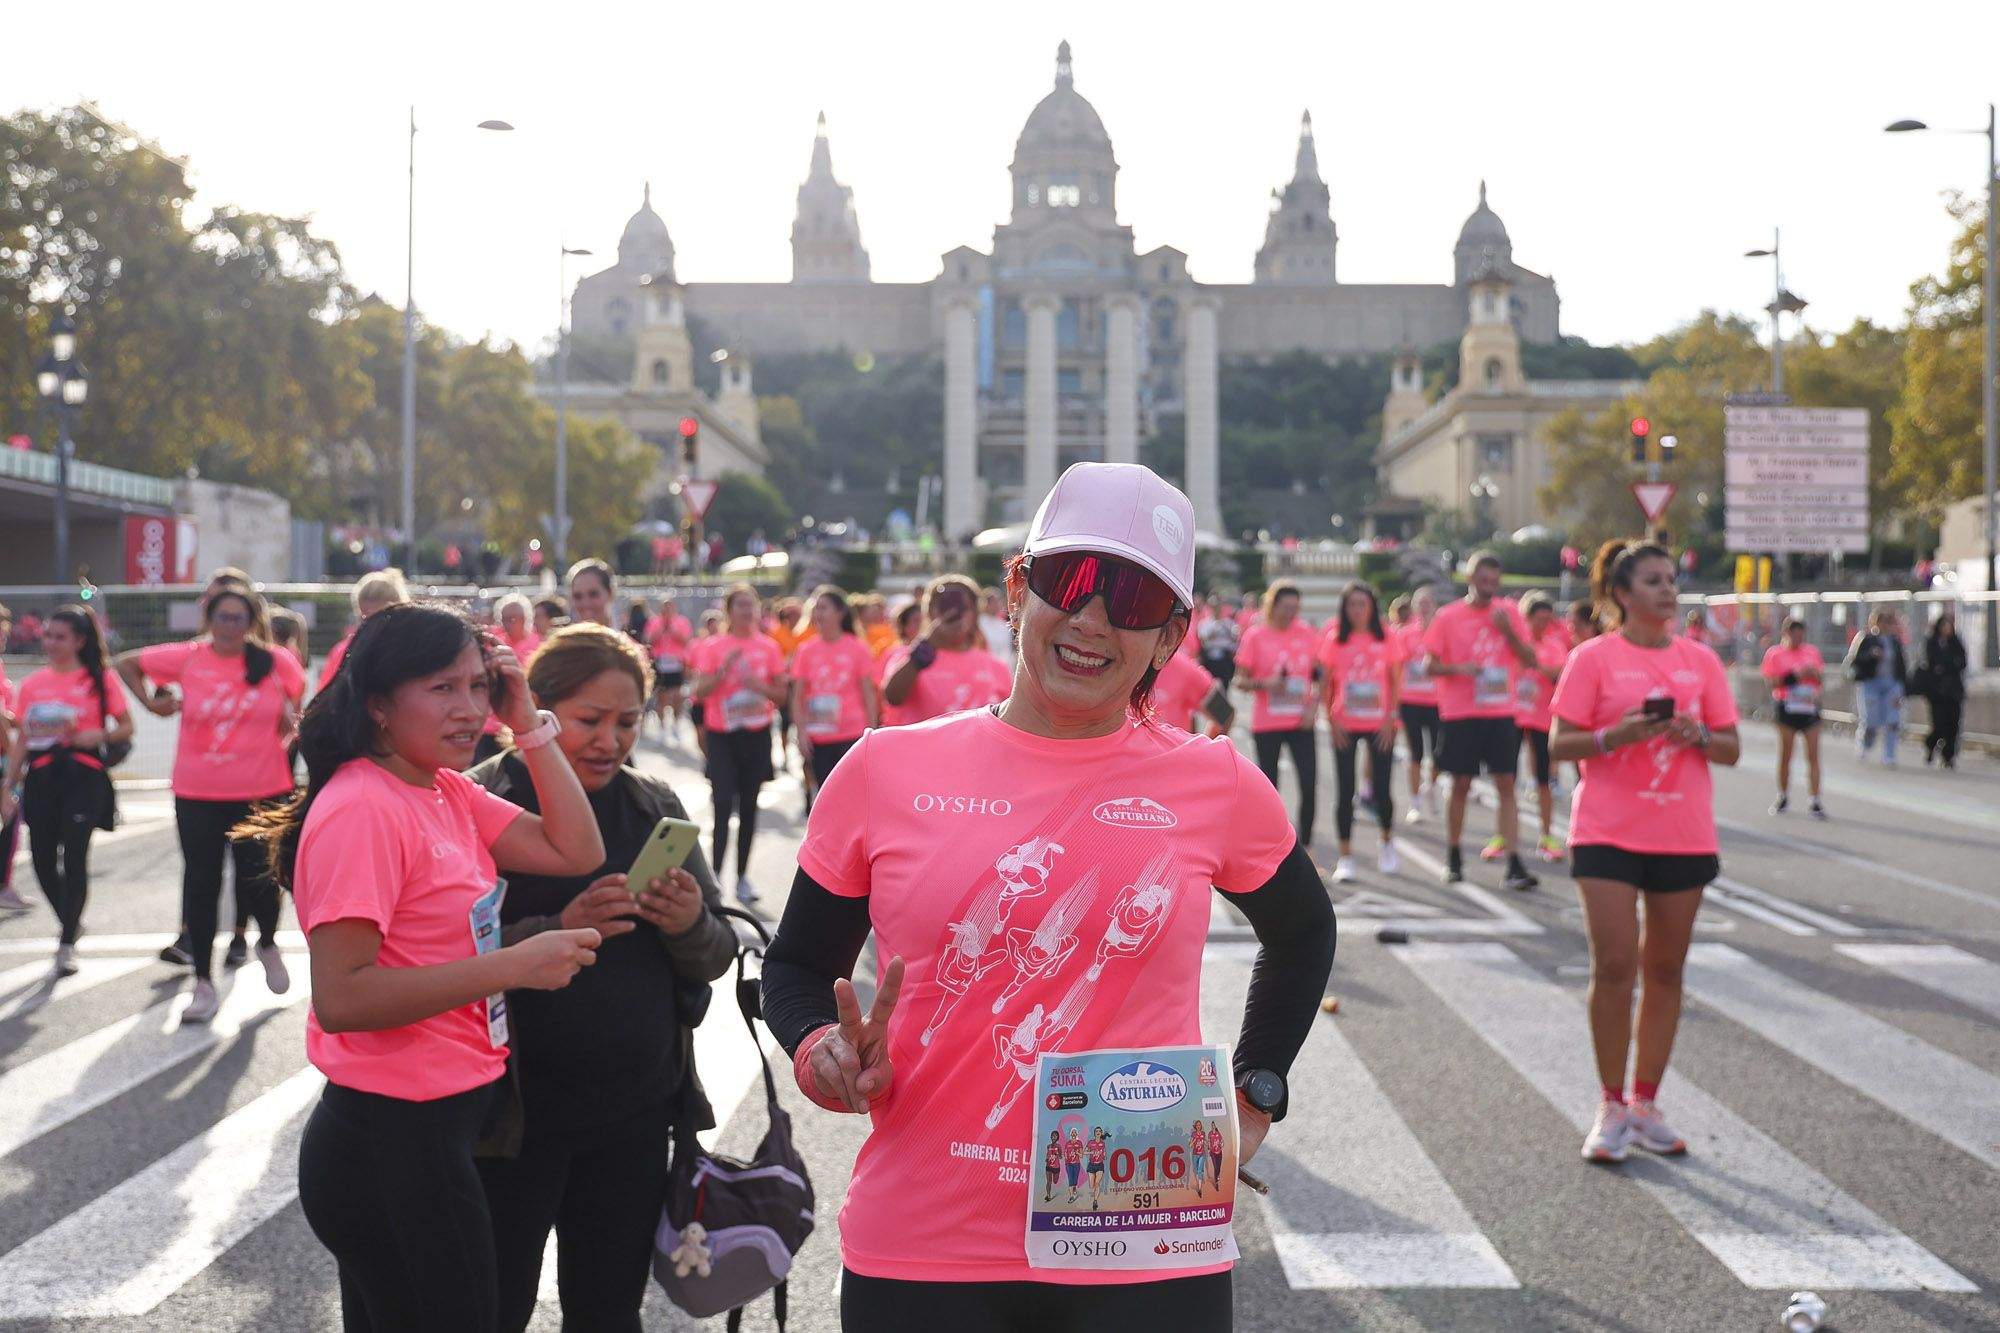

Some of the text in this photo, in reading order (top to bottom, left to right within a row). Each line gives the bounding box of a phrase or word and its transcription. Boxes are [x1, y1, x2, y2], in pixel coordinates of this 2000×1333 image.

[913, 794, 1012, 816] OYSHO
[1100, 807, 1172, 824] ASTURIANA
[1050, 1074, 1085, 1088] SUMA
[1106, 1080, 1183, 1101] ASTURIANA
[950, 1141, 1031, 1165] CARRERA DE L
[1109, 1144, 1186, 1183] 016
[998, 1166, 1028, 1184] 2024
[1133, 1191, 1160, 1209] 591
[1053, 1207, 1226, 1227] CARRERA DE LA MUJER BARCELONA
[1052, 1239, 1127, 1257] OYSHO
[1172, 1237, 1224, 1254] Santander
